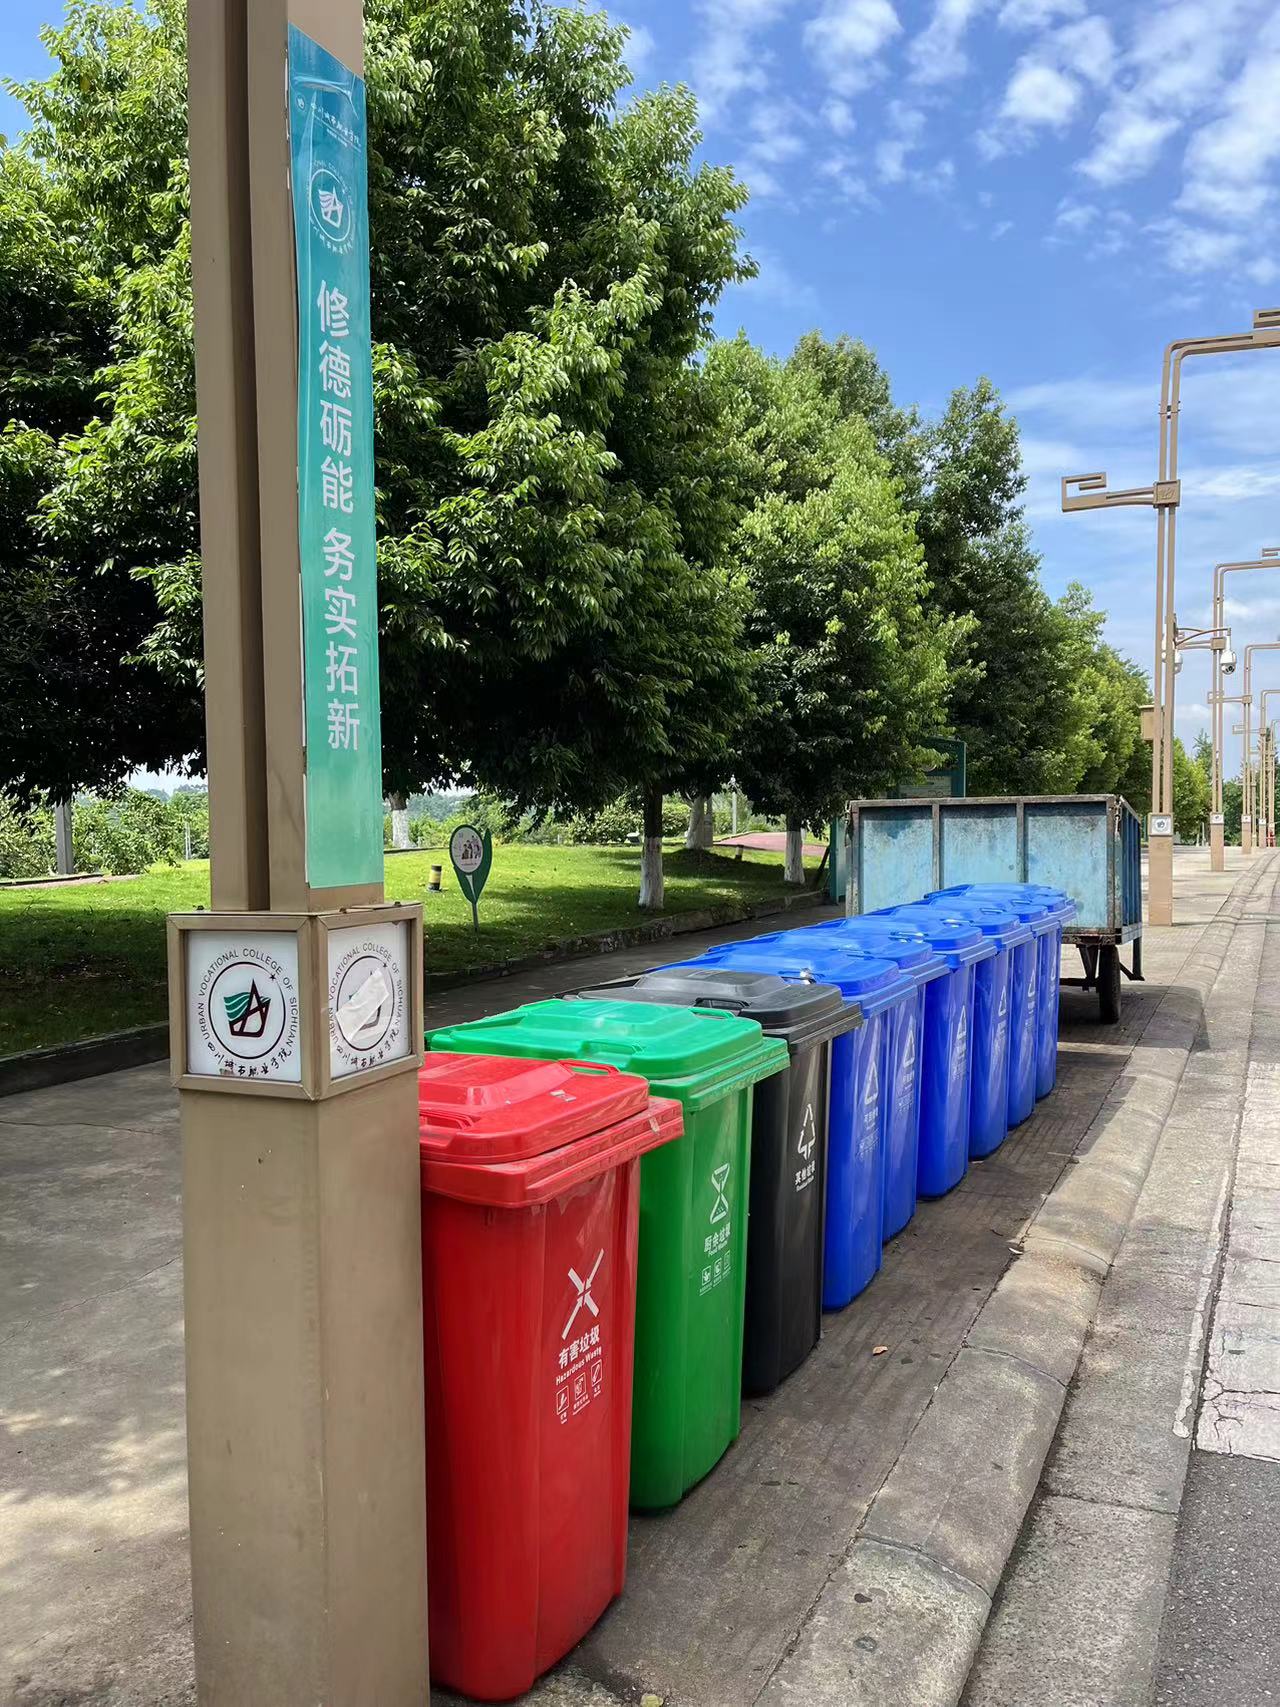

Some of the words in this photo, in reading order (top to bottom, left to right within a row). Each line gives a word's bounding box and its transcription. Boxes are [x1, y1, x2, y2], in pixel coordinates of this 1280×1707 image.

[316, 280, 354, 514] 修德砺能
[322, 527, 360, 751] 务实拓新
[243, 948, 283, 976] COLLEGE
[362, 942, 393, 962] COLLEGE
[391, 962, 400, 975] OF
[198, 950, 239, 997] VOCATIONAL
[282, 977, 294, 991] OF
[328, 946, 361, 1003] VOCATIONAL
[198, 1002, 211, 1040] URBAN
[285, 996, 298, 1049] SICHUAN
[396, 979, 405, 1029] SICHUAN
[328, 1007, 339, 1044] URBAN
[558, 1324, 600, 1369] 有害垃圾
[555, 1356, 586, 1386] Hazardous
